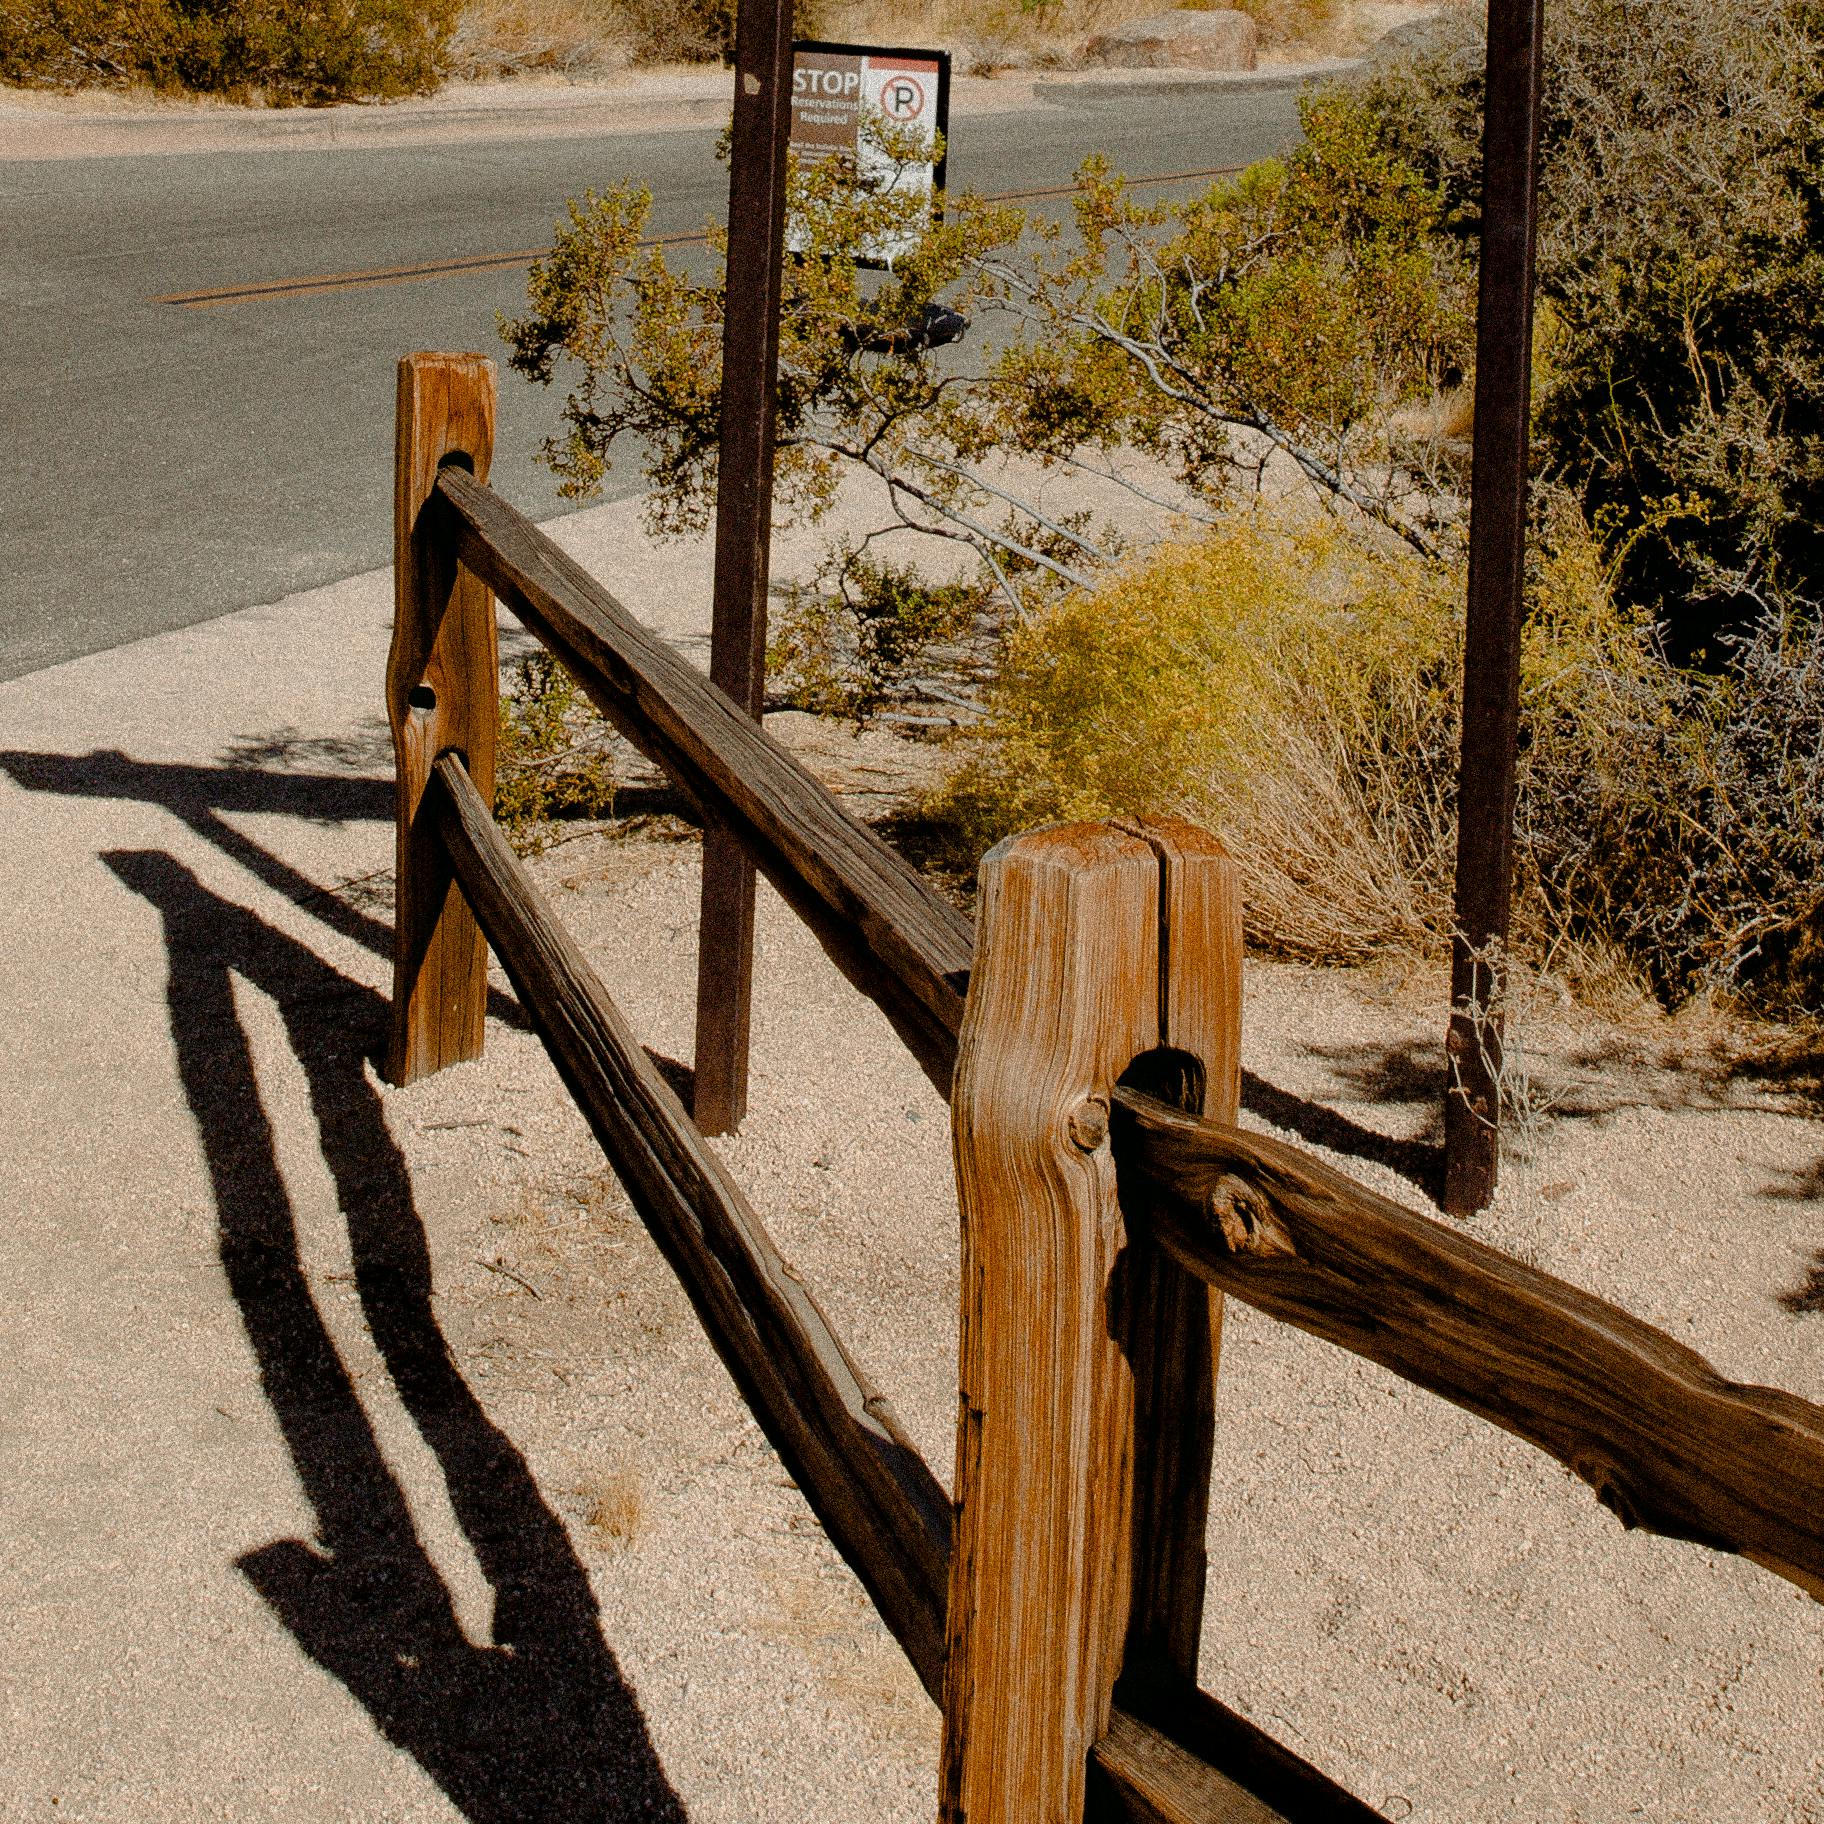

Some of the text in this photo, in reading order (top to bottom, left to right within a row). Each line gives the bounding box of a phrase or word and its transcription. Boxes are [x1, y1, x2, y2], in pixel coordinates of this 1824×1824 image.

[793, 68, 859, 95] STOP
[790, 96, 858, 111] Reservations
[799, 111, 849, 125] Required
